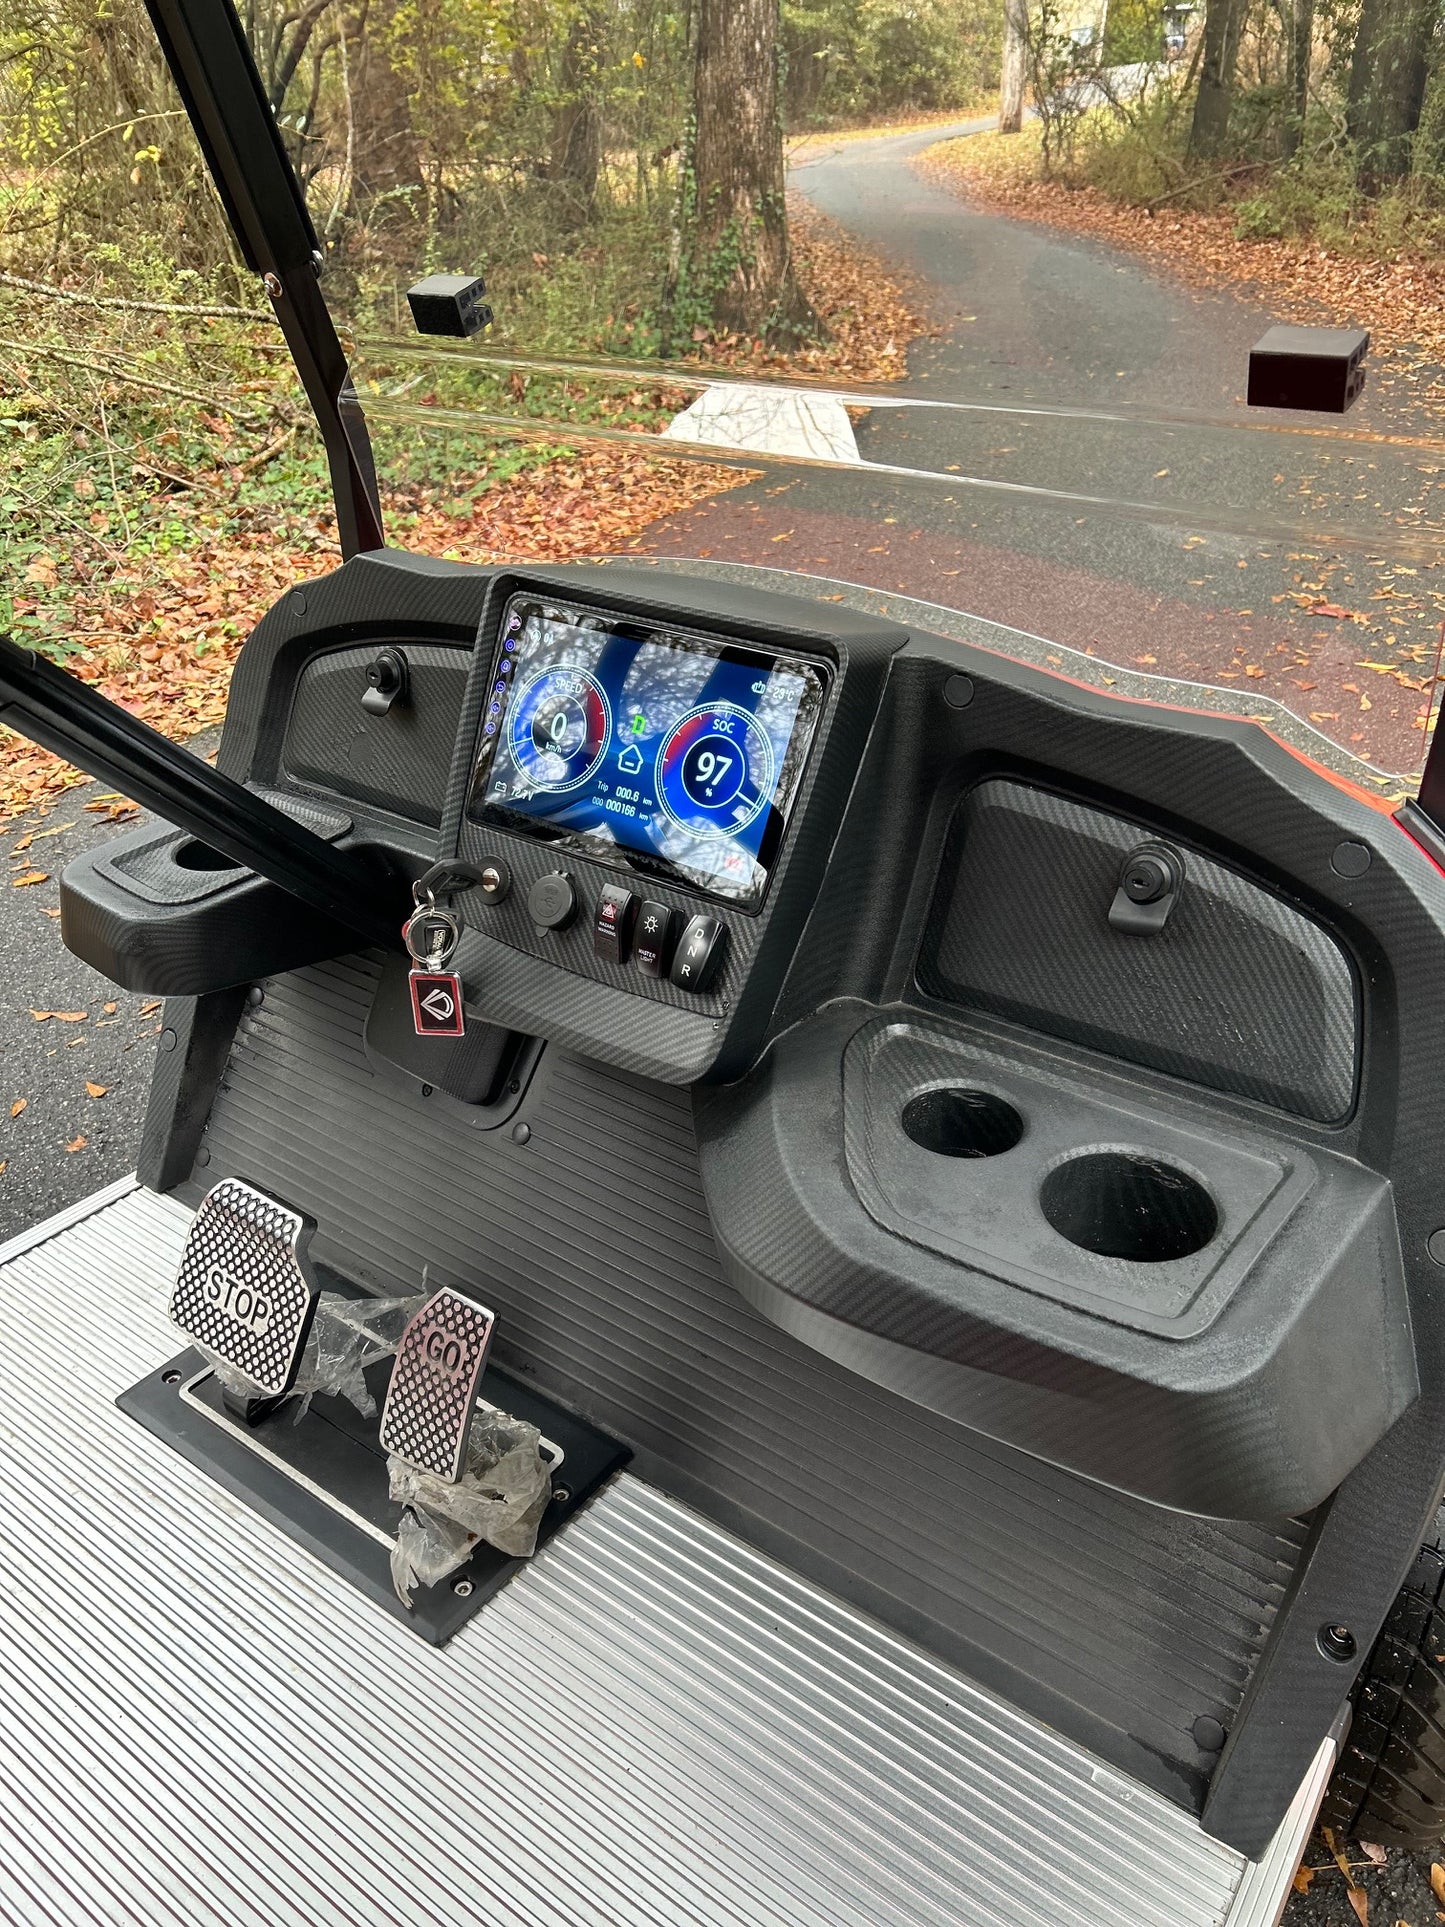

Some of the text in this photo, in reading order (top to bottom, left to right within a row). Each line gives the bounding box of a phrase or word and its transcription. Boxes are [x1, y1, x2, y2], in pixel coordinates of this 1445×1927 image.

[554, 678, 583, 694] SPEED
[550, 712, 567, 741] 0
[631, 714, 646, 735] D
[712, 718, 736, 734] SOC
[545, 741, 562, 754] km/h
[695, 751, 733, 786] 97
[597, 780, 653, 807] Trip 000.6 km
[705, 787, 713, 797] %
[605, 799, 636, 817] 000166
[638, 812, 649, 821] km
[598, 920, 616, 931] HAZARD
[694, 927, 705, 939] D
[687, 945, 698, 958] N
[681, 963, 691, 977] R
[207, 1270, 269, 1327] STOP
[426, 1330, 462, 1374] GO
